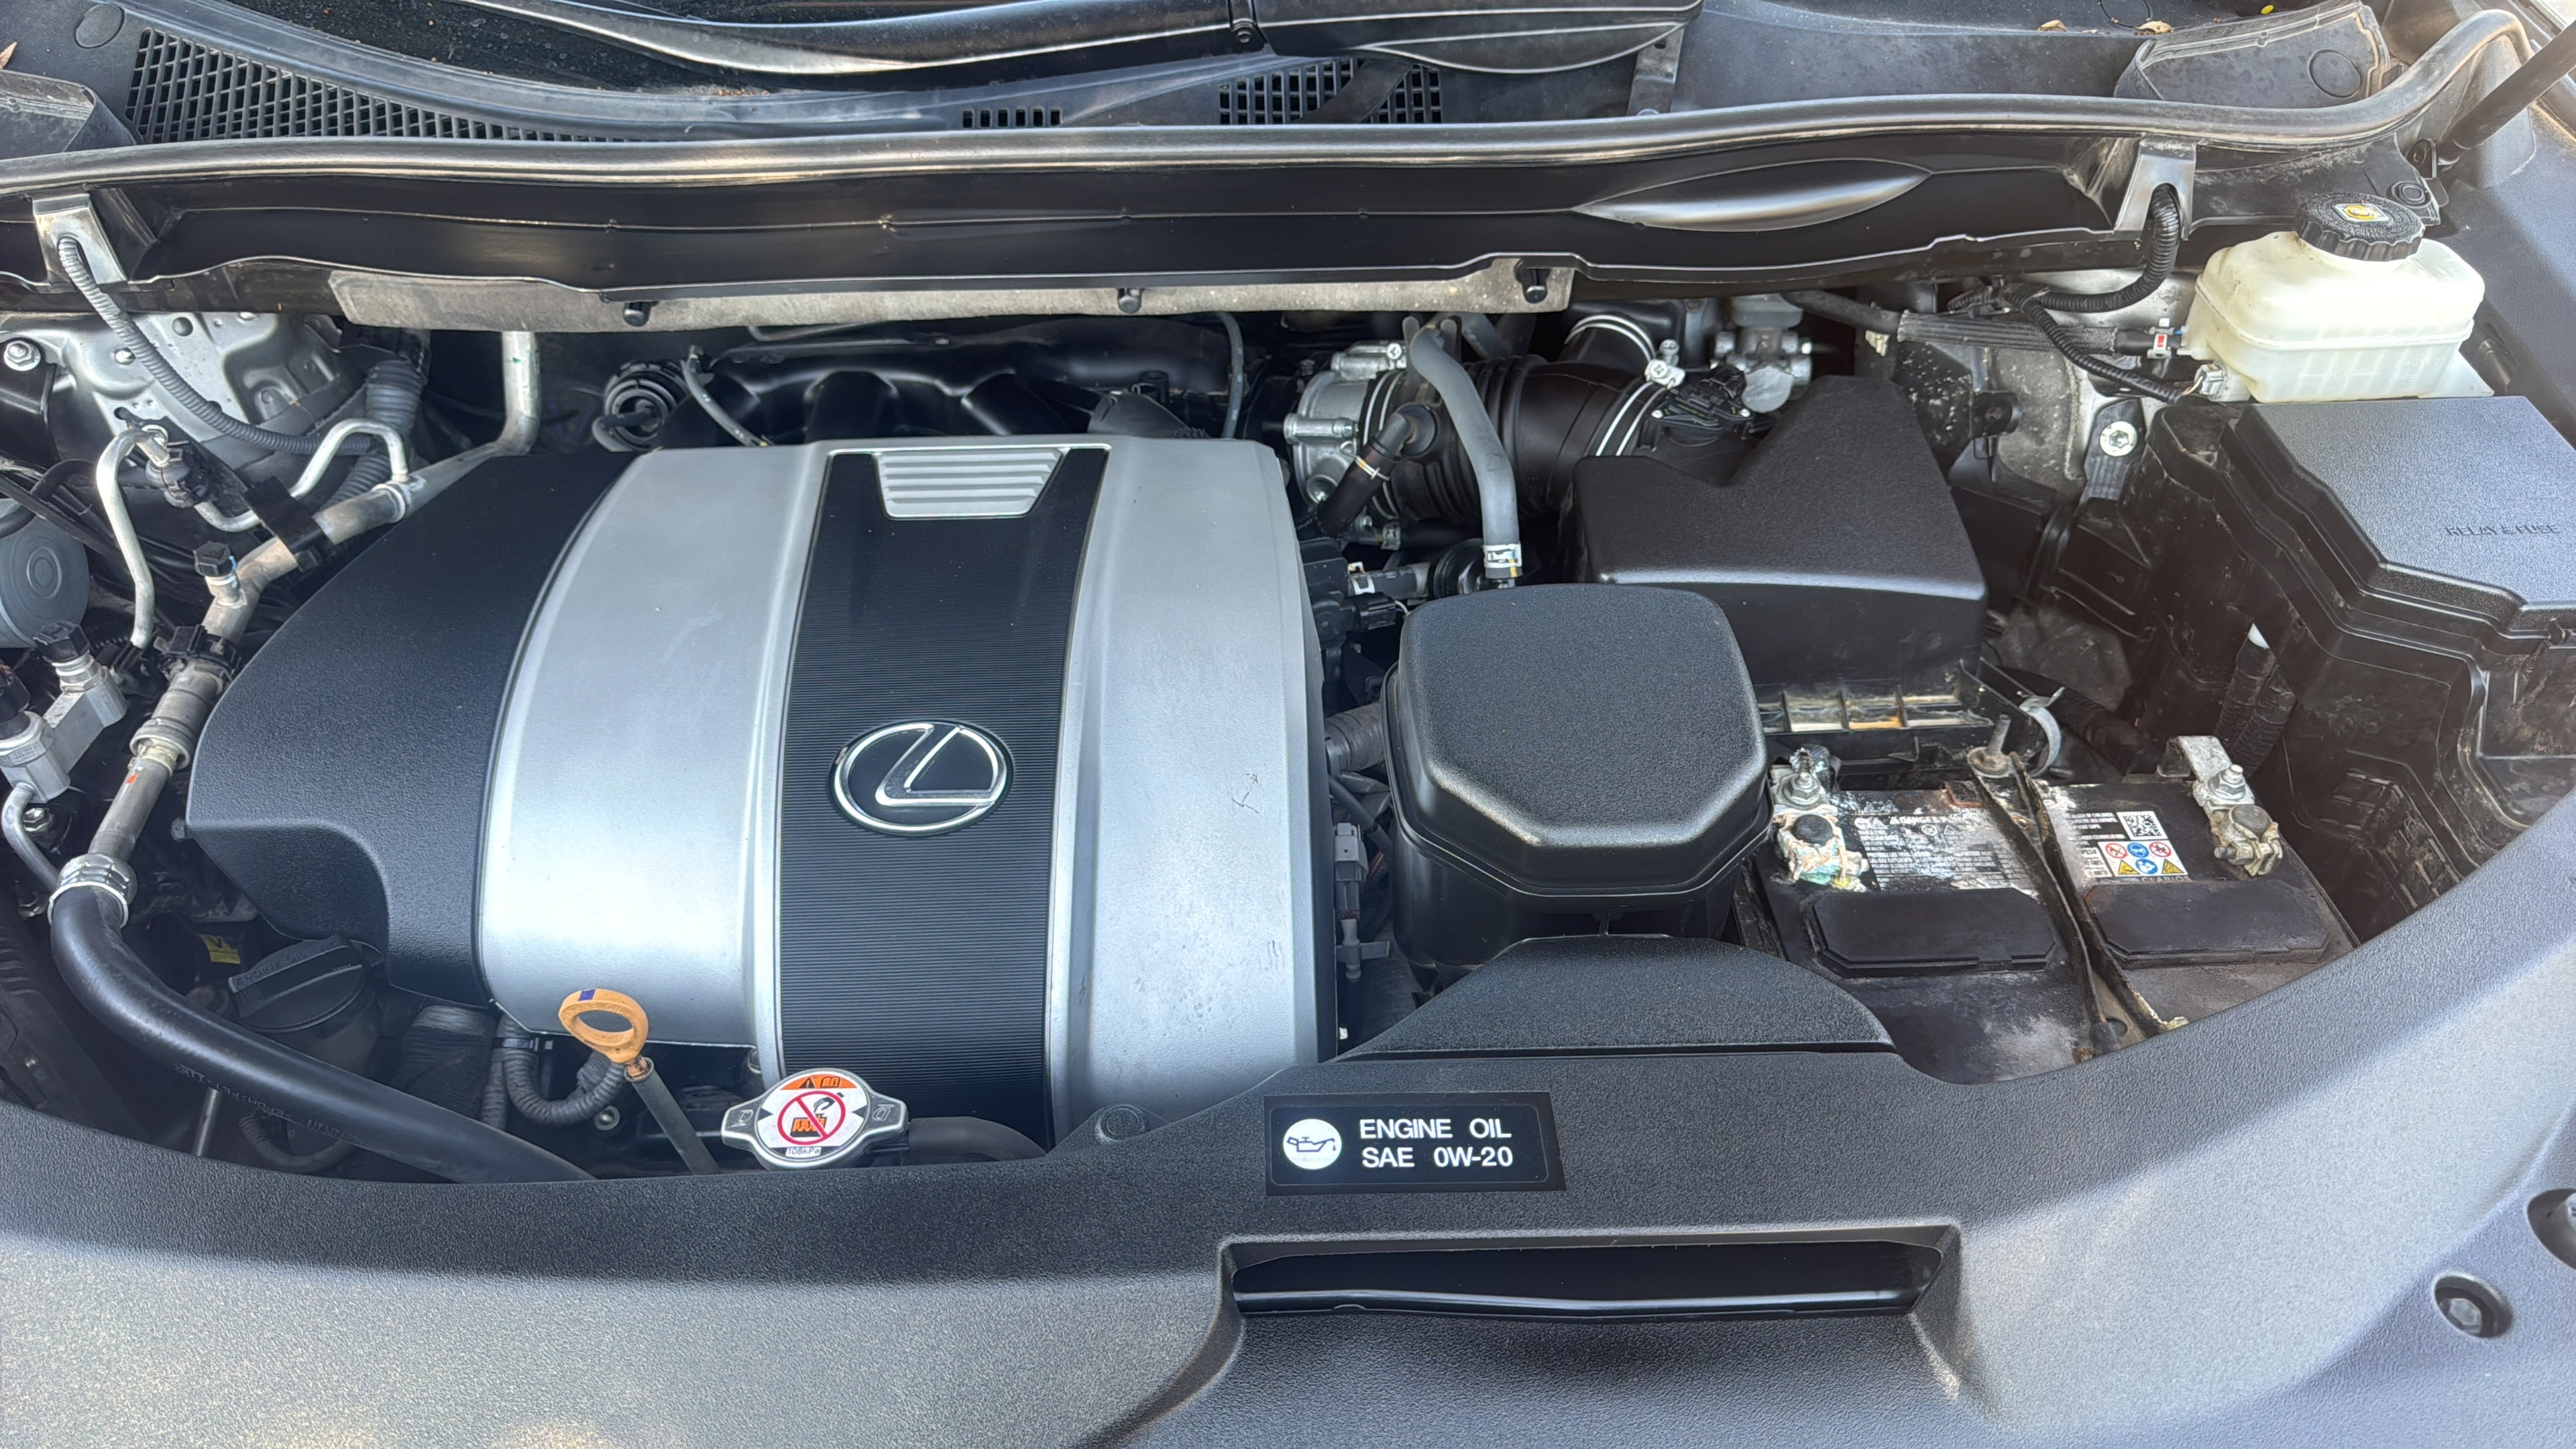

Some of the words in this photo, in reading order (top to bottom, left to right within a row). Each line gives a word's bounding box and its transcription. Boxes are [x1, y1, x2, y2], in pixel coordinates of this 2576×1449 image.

[2445, 525, 2499, 536] RELAY
[2515, 524, 2561, 535] FUSE
[606, 1004, 623, 1014] OIL
[1359, 1118, 1453, 1139] ENGINE
[1469, 1118, 1512, 1139] OIL
[786, 1146, 821, 1156] 108kPa
[1361, 1146, 1415, 1168] SAE
[1433, 1145, 1514, 1168] 0W-20
